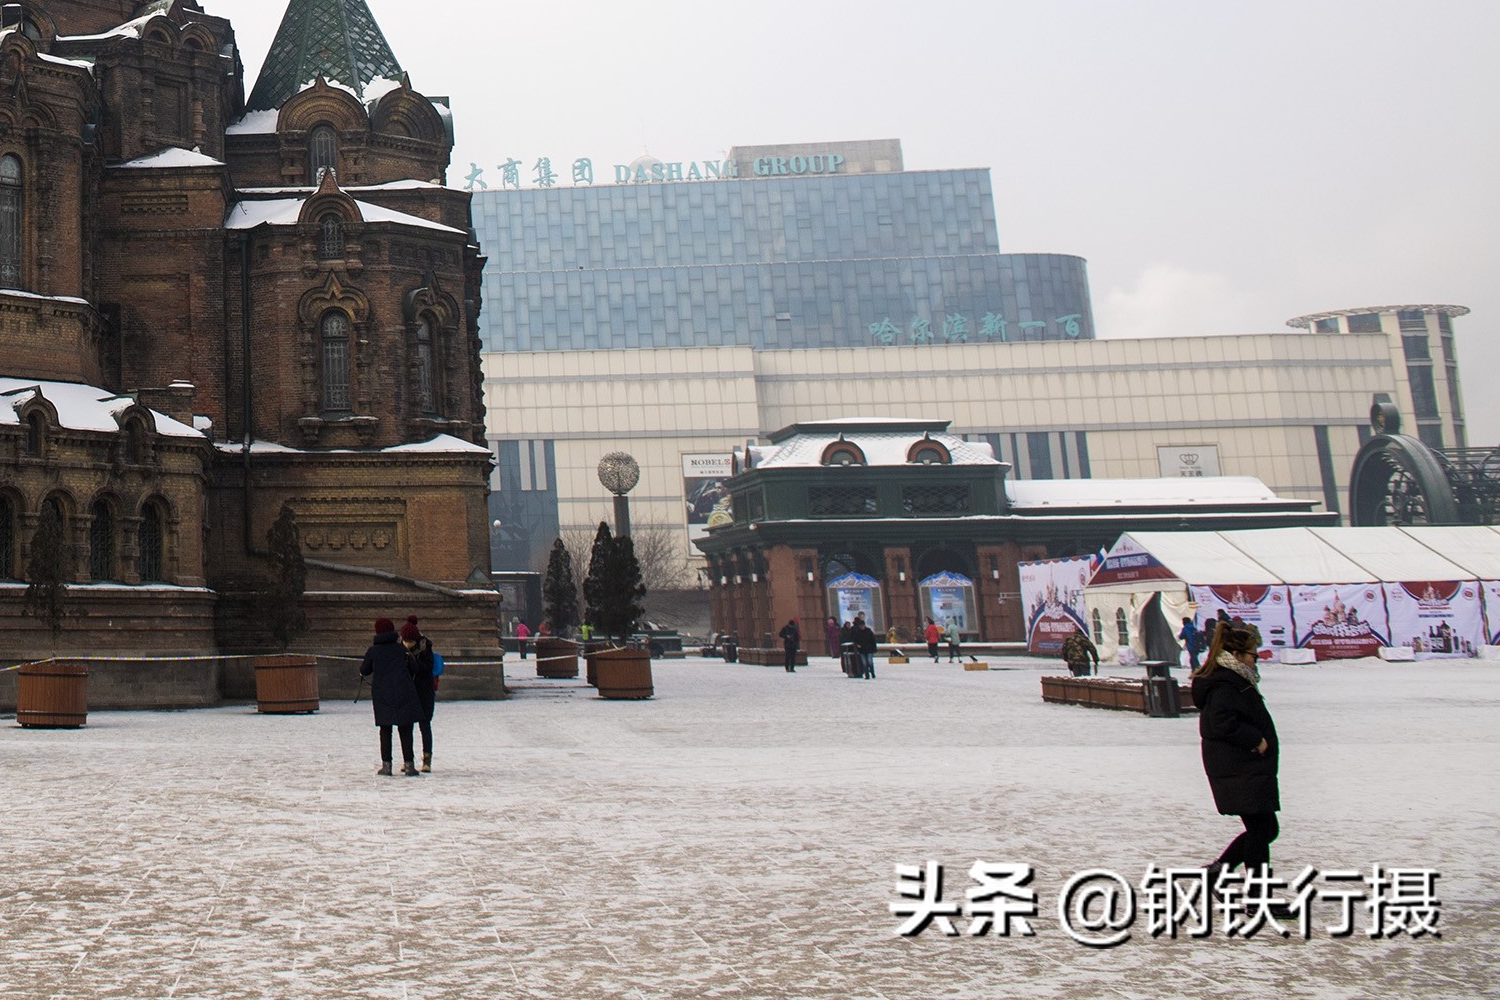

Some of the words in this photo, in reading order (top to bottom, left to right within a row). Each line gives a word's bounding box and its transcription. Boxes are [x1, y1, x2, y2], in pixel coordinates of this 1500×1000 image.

[463, 157, 596, 189] 大商集团
[614, 159, 739, 184] DASHANG
[754, 153, 845, 177] GROUP
[869, 312, 1082, 344] 哈尔滨新一百
